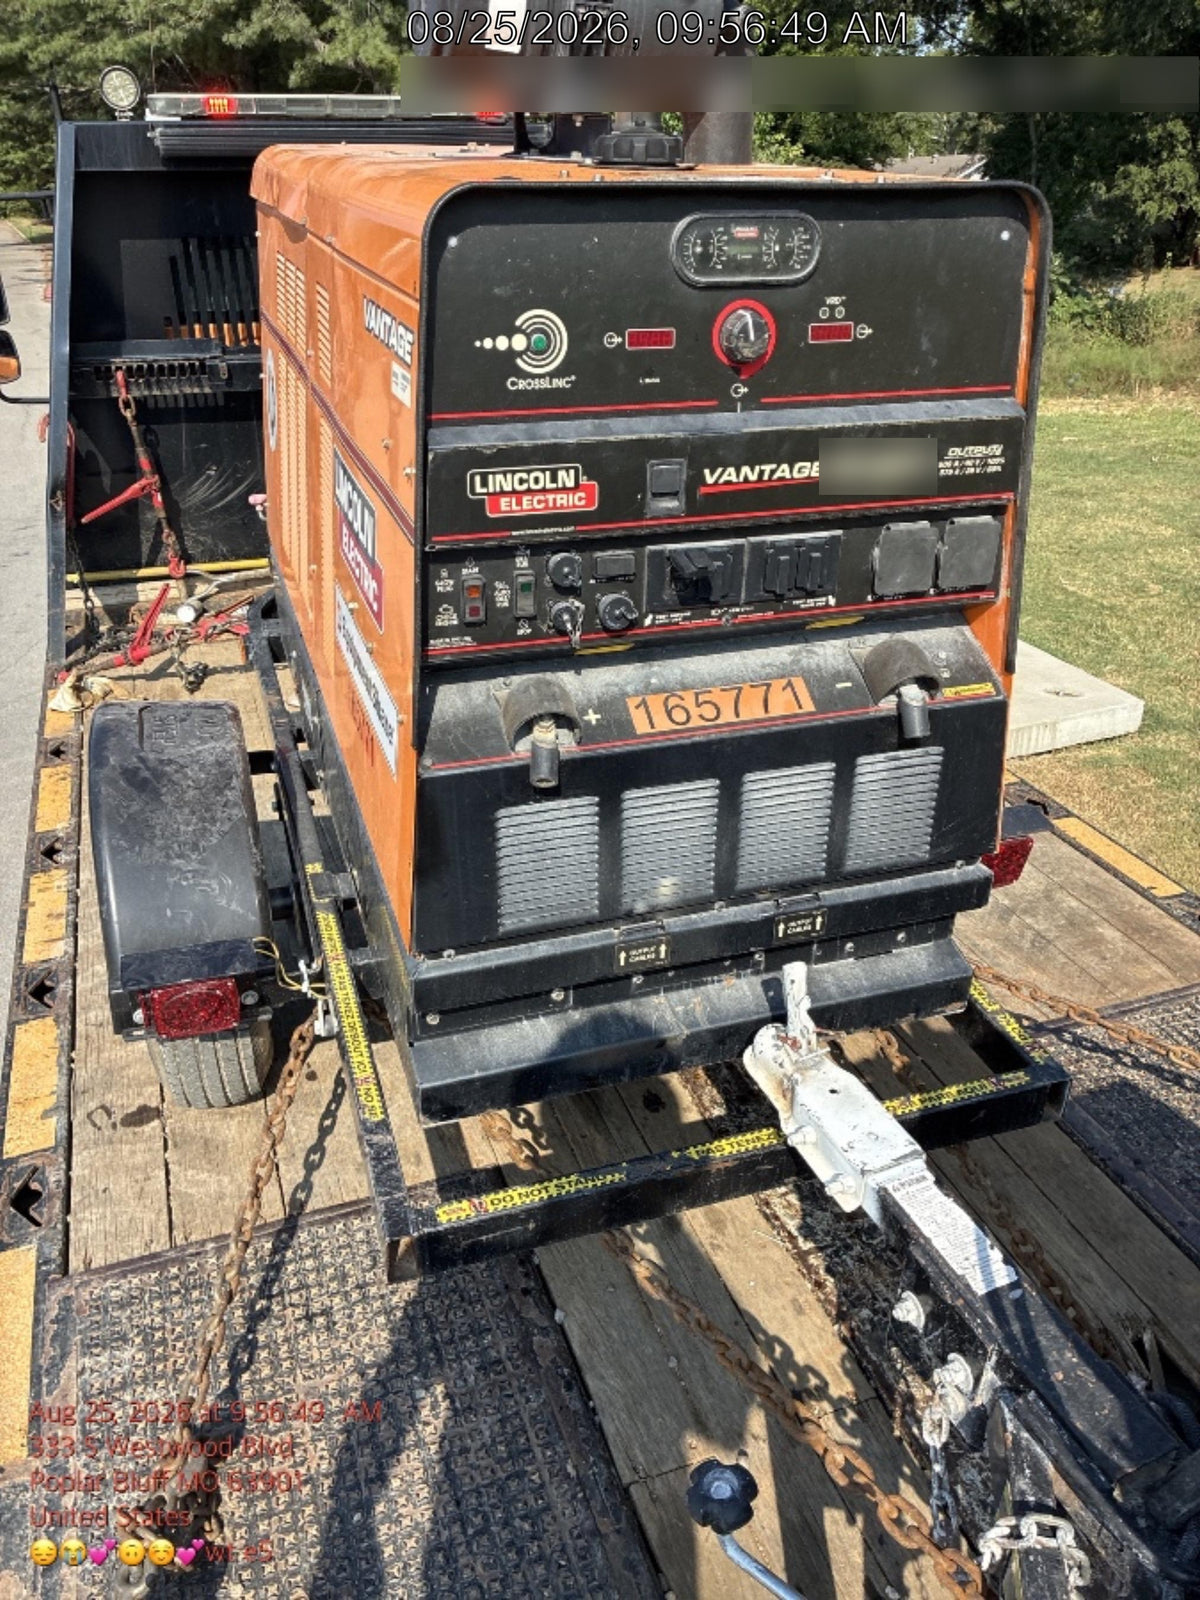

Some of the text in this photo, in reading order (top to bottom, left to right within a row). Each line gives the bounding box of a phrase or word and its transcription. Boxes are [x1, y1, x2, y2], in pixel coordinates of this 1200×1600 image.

[474, 468, 576, 494] LINCOLN
[500, 492, 587, 512] ELECTRIC
[634, 678, 803, 730] 165771
[490, 1193, 515, 1207] DO
[518, 1185, 549, 1201] NOT
